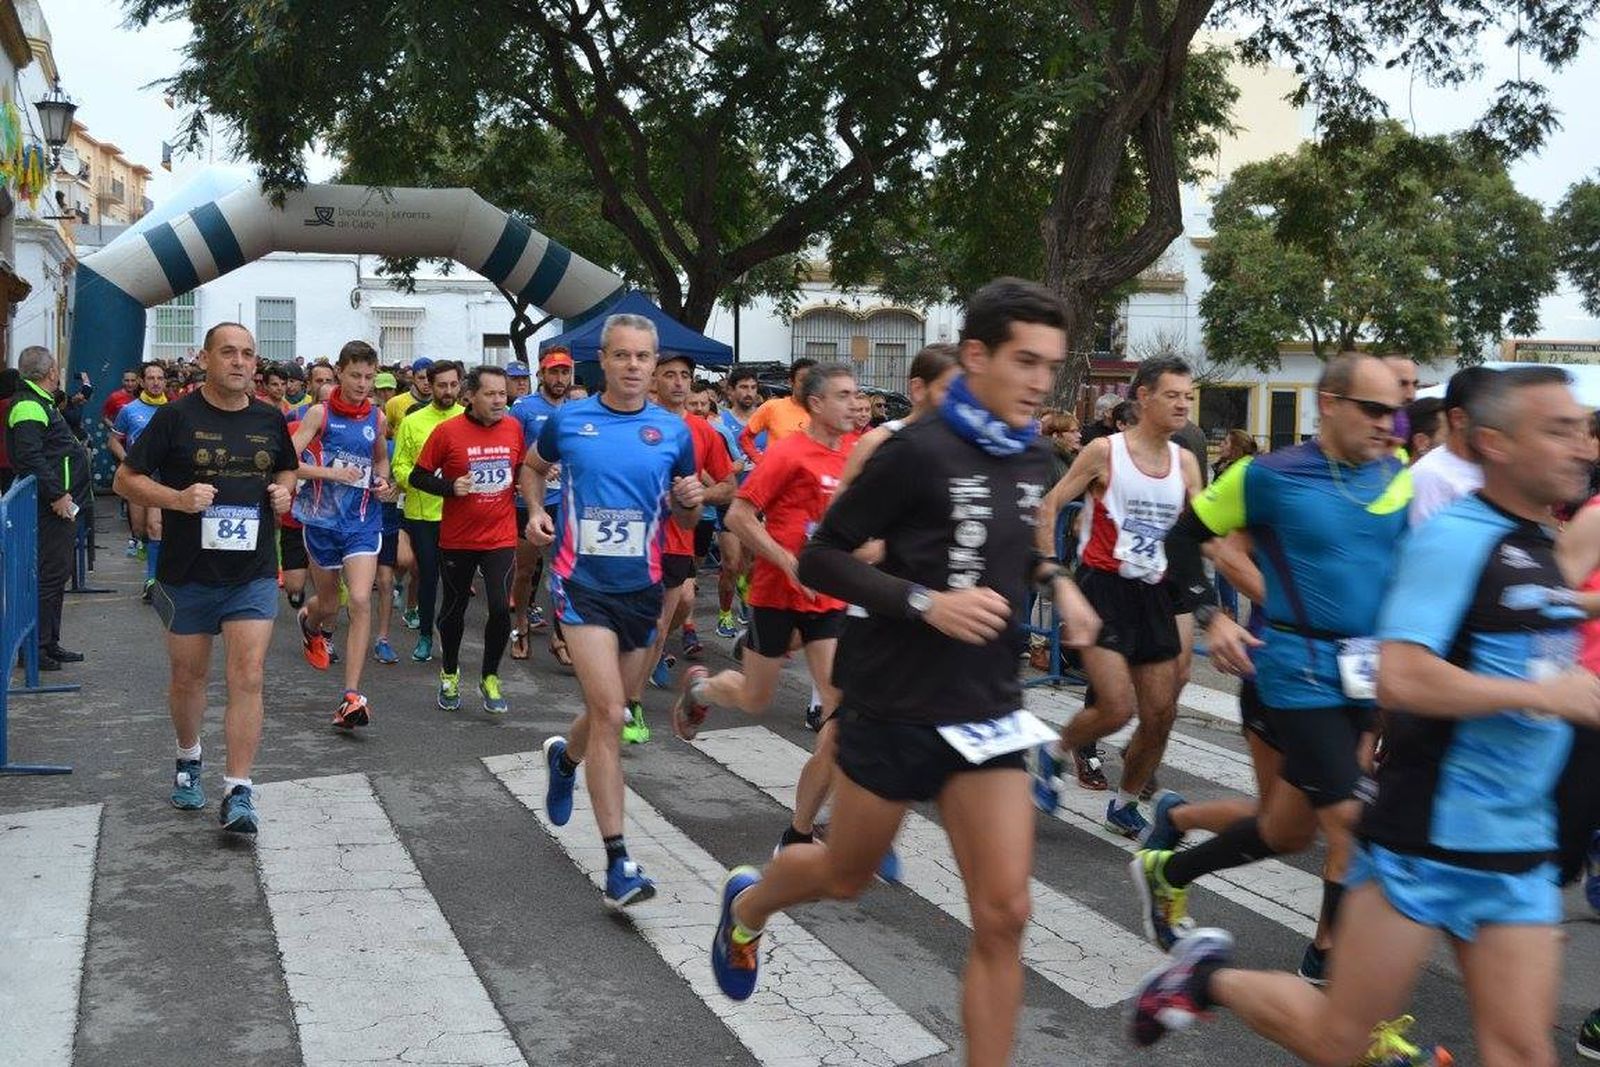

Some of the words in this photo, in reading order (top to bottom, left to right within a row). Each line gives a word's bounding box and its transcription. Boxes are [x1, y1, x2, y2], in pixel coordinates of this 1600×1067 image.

[475, 469, 506, 484] 219
[217, 519, 247, 539] 84
[597, 520, 629, 543] 55
[1130, 535, 1156, 558] 24
